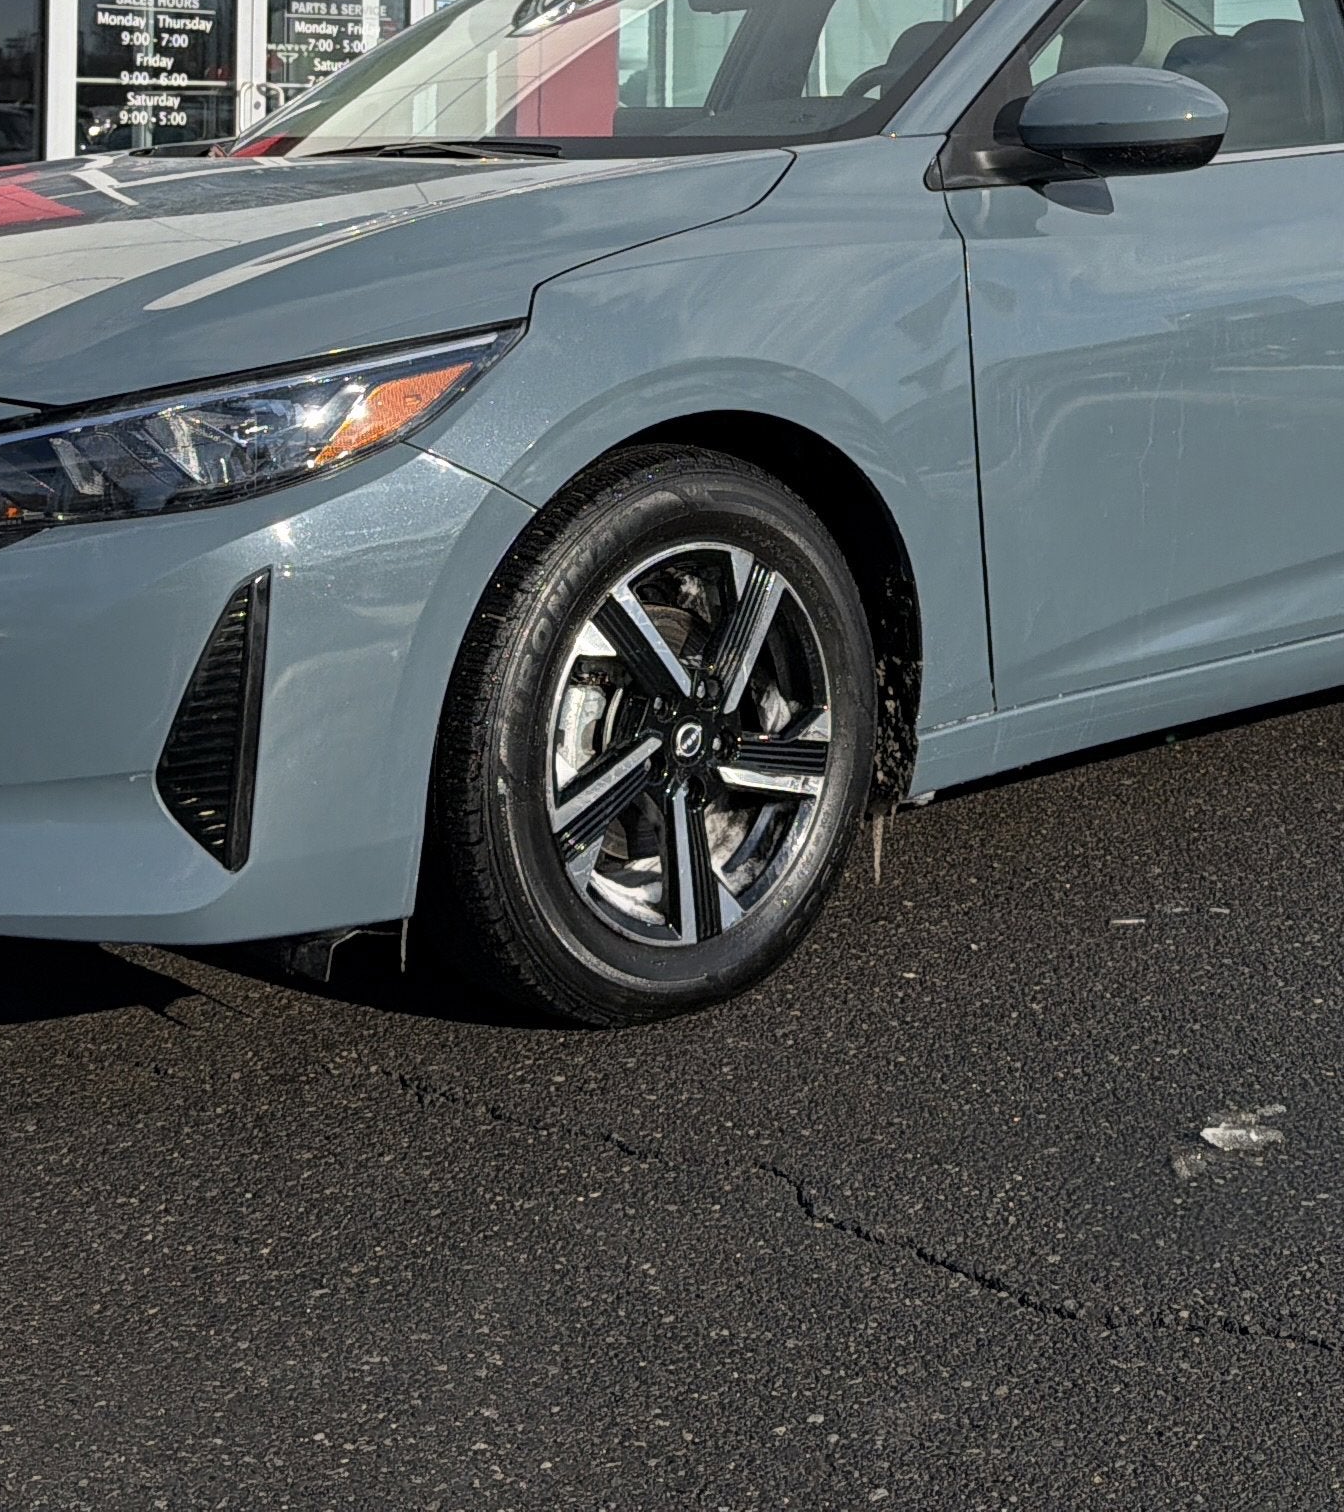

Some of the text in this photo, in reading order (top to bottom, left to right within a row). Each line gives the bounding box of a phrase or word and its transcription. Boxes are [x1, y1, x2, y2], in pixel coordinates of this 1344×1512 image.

[291, 1, 328, 15] PARTS
[330, 3, 338, 15] &
[97, 11, 147, 29] Monday
[157, 14, 213, 34] Thursday
[295, 21, 339, 37] Monday
[121, 31, 150, 46] 9:00
[160, 33, 189, 47] 7:00
[308, 39, 334, 52] 7:00
[343, 40, 367, 54] 5:00
[136, 53, 175, 70] Friday
[120, 71, 150, 85] 9:00
[159, 72, 188, 86] 6:00
[127, 92, 181, 109] Saturday
[119, 110, 148, 125] 9:00
[159, 111, 187, 126] 5:00
